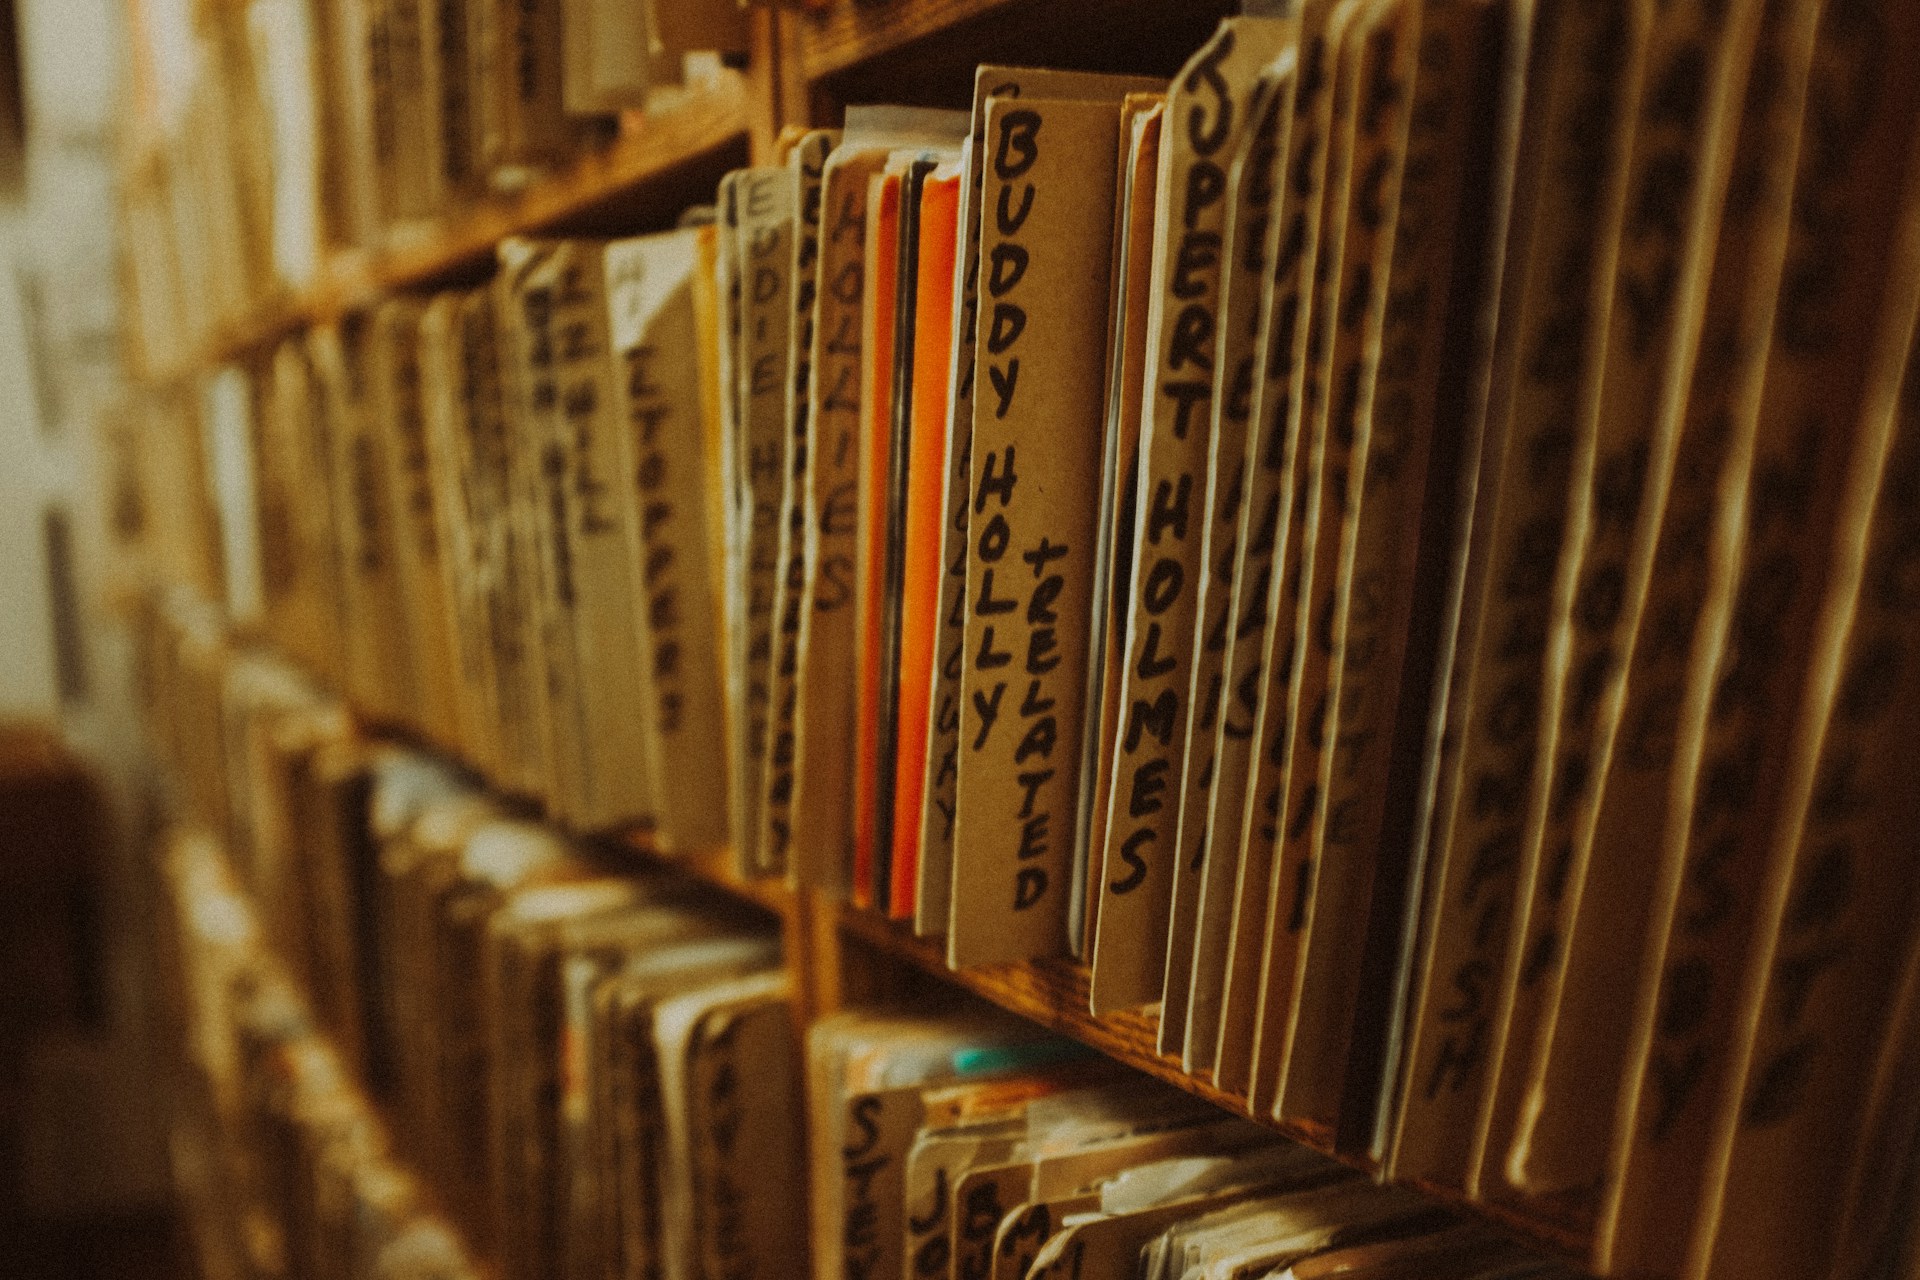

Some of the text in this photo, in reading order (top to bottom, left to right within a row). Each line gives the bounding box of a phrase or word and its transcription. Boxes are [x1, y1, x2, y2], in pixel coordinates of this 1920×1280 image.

[986, 109, 1042, 419] BUDDY
[973, 445, 1018, 752] HOLLY
[1110, 473, 1192, 896] HOLMES
